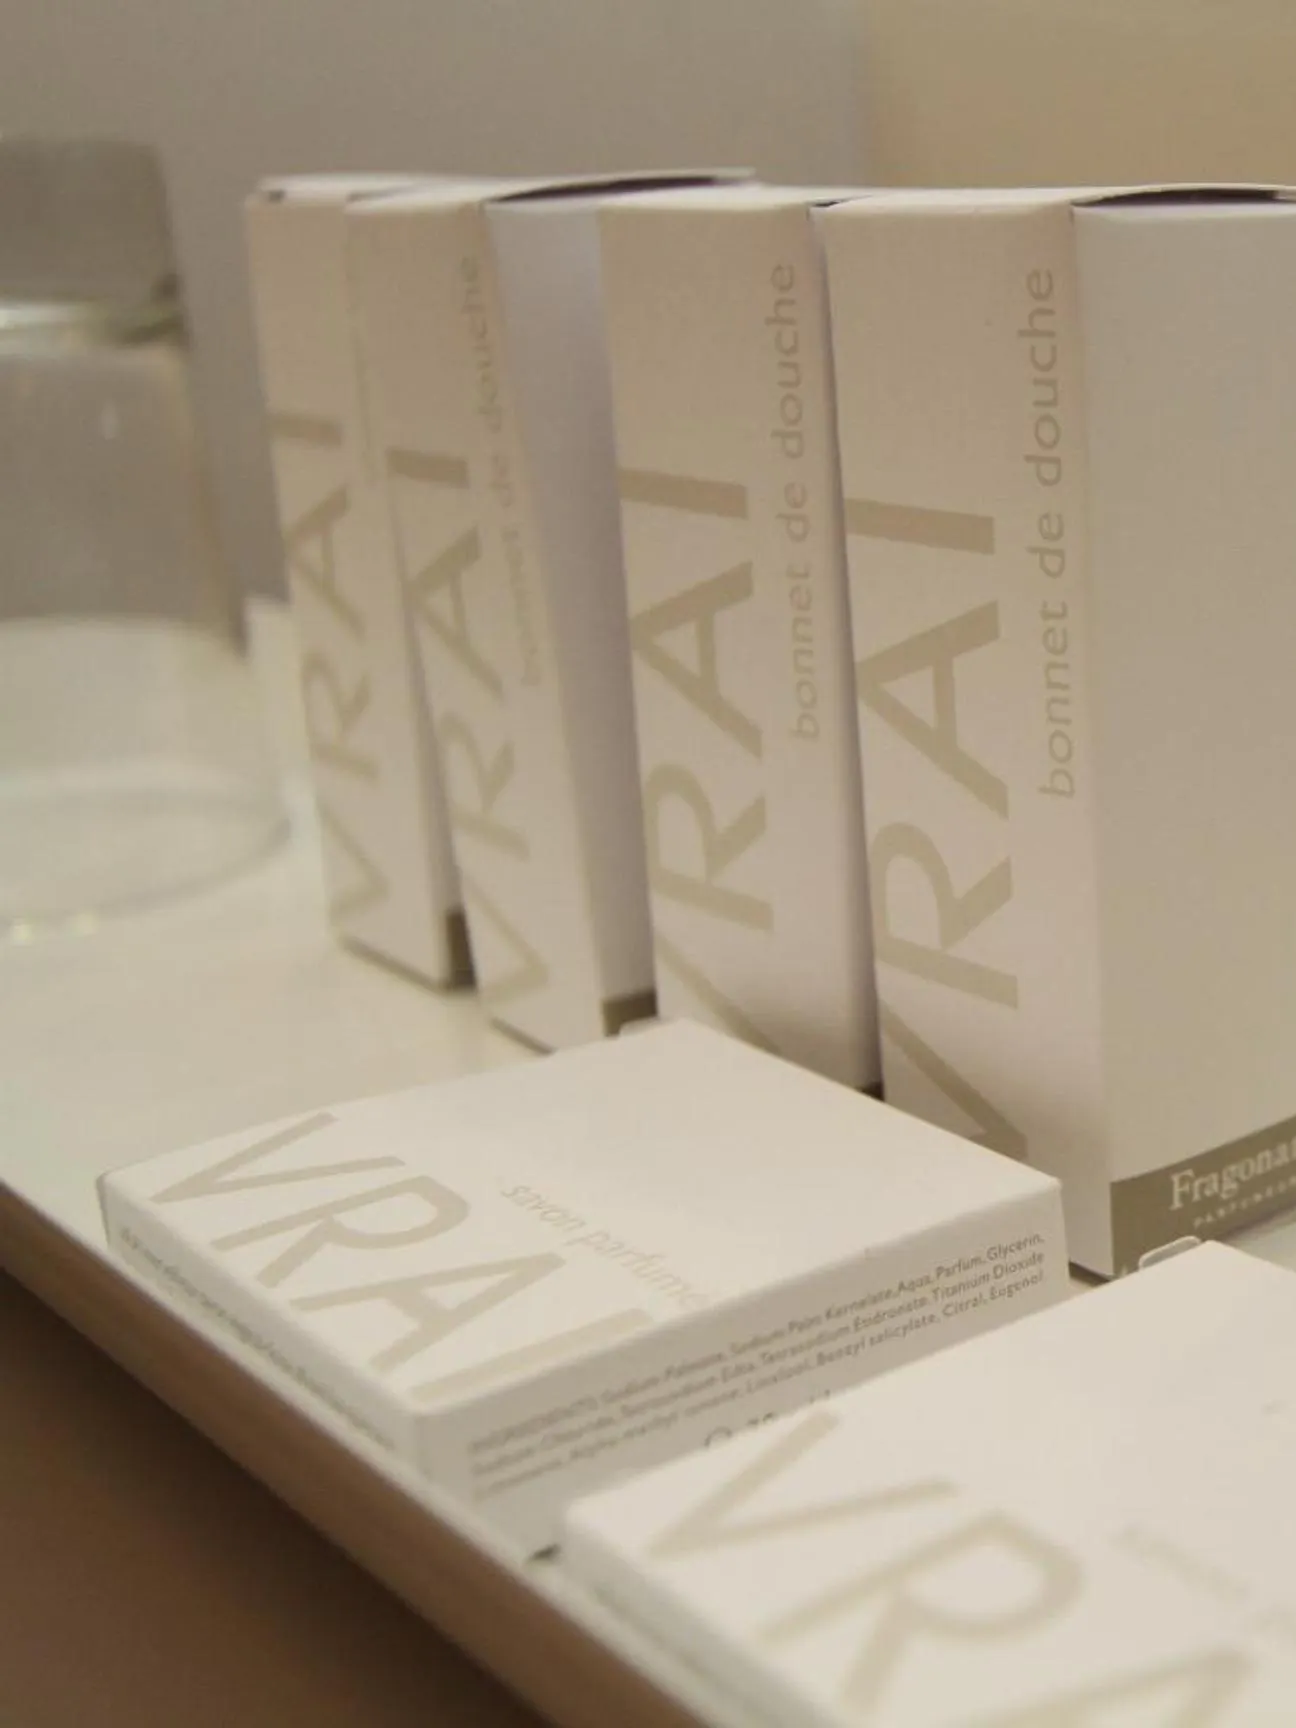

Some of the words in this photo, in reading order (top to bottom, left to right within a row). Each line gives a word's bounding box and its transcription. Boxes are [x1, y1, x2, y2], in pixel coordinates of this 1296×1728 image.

[765, 262, 804, 460] douche
[1017, 266, 1064, 488] douche
[775, 481, 812, 544] de
[1026, 511, 1067, 580] de
[266, 410, 391, 930] VRAI
[386, 446, 550, 1002] VRAI
[788, 562, 821, 743] bonnet
[1038, 598, 1076, 799] bonnet
[149, 1111, 655, 1402] VRAI
[500, 1185, 587, 1233] savon
